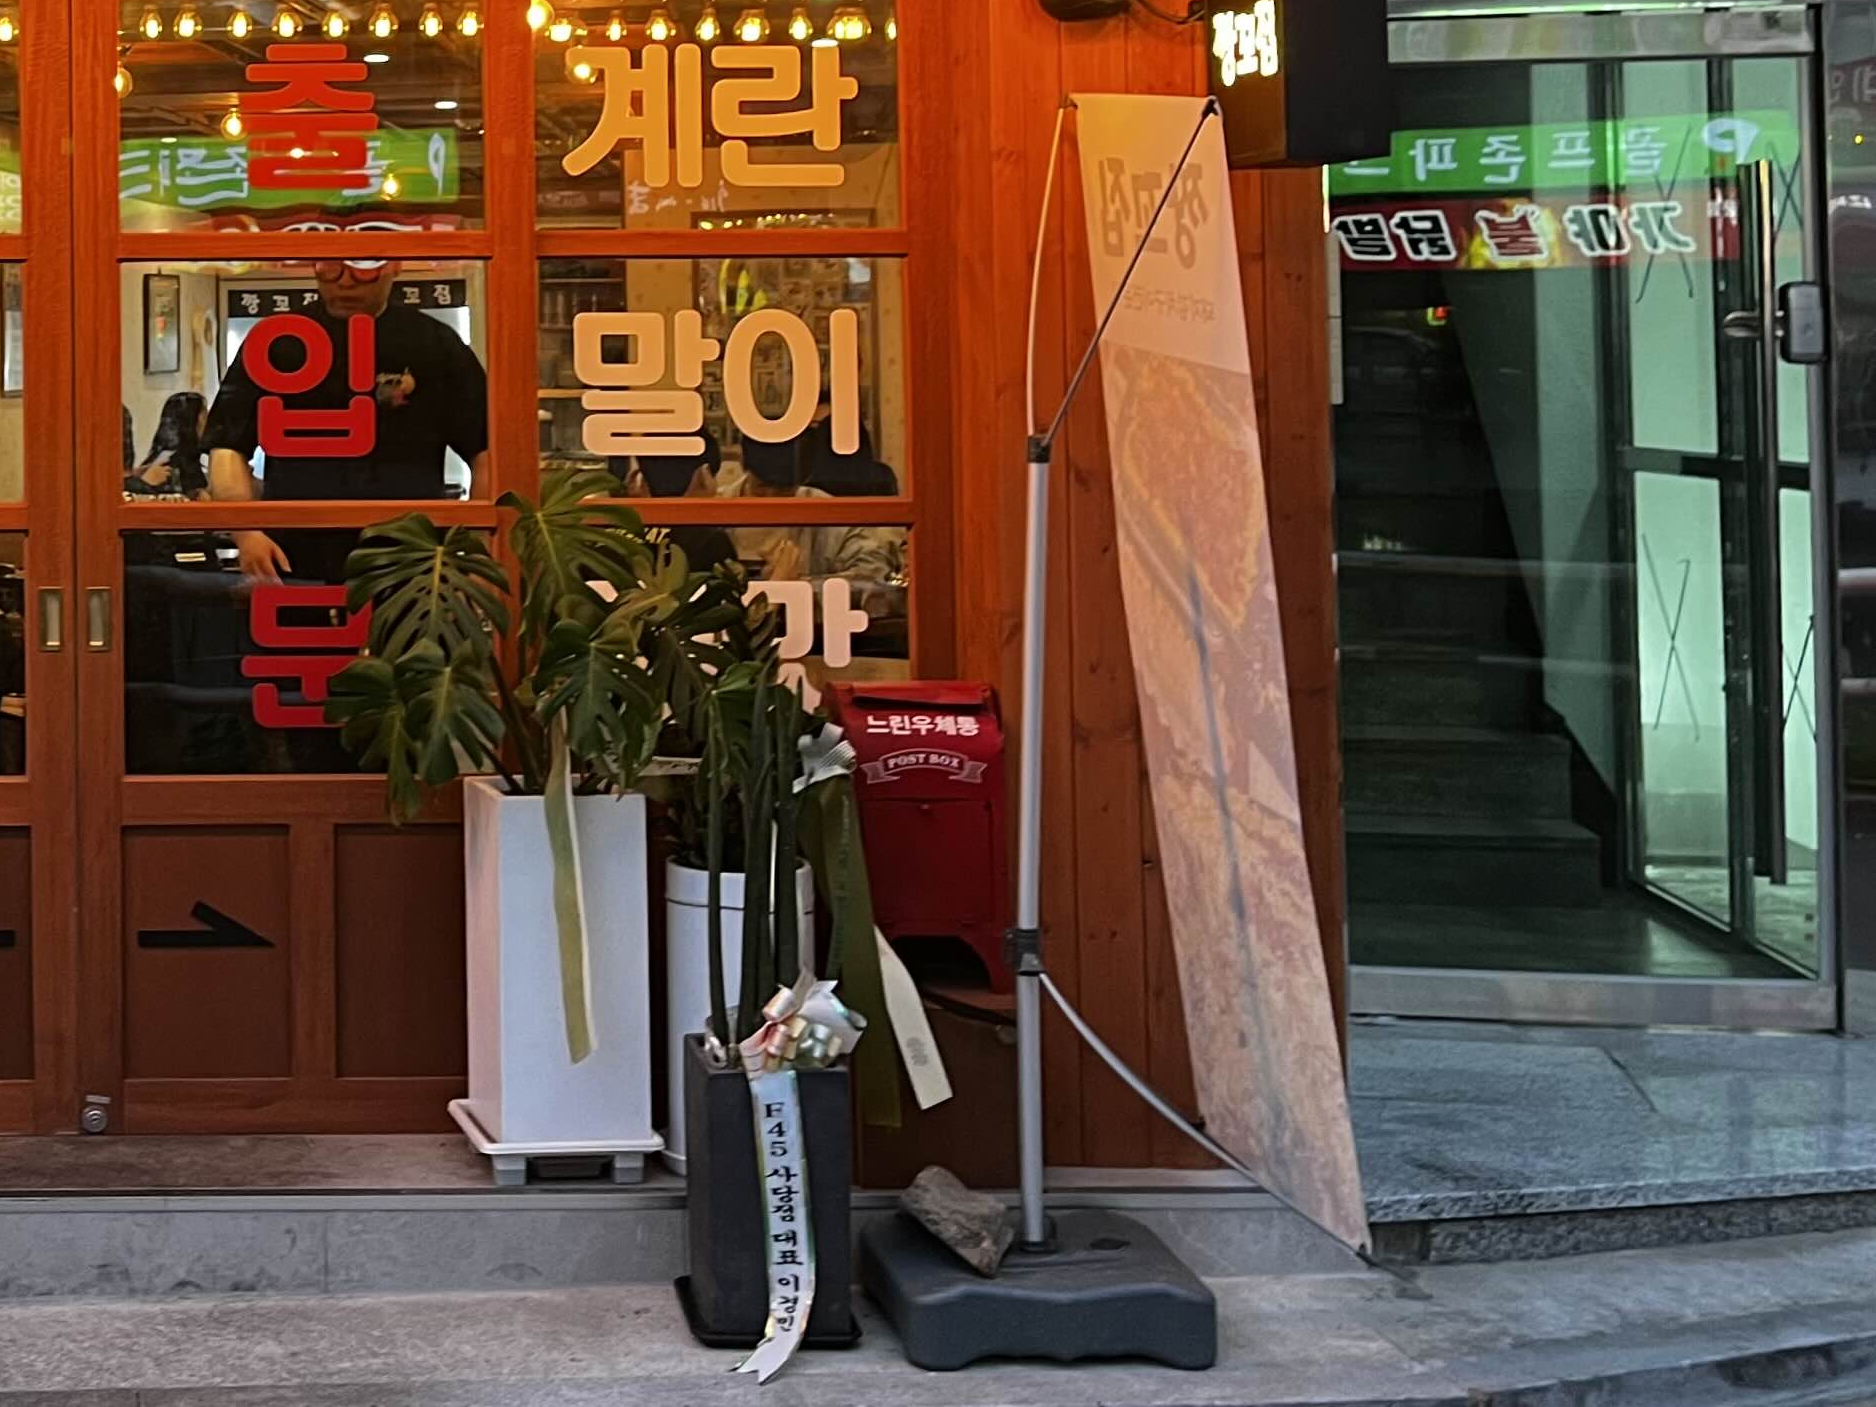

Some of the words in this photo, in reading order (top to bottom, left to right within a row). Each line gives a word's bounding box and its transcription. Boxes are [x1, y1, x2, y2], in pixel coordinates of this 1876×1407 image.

[562, 42, 860, 188] 계란
[571, 307, 862, 458] 말이
[866, 715, 981, 736] 느린우체통
[887, 754, 926, 769] POST
[928, 754, 961, 769] BOX
[764, 1101, 789, 1158] F45
[765, 1165, 800, 1223] 사당점
[772, 1229, 804, 1266] 대표
